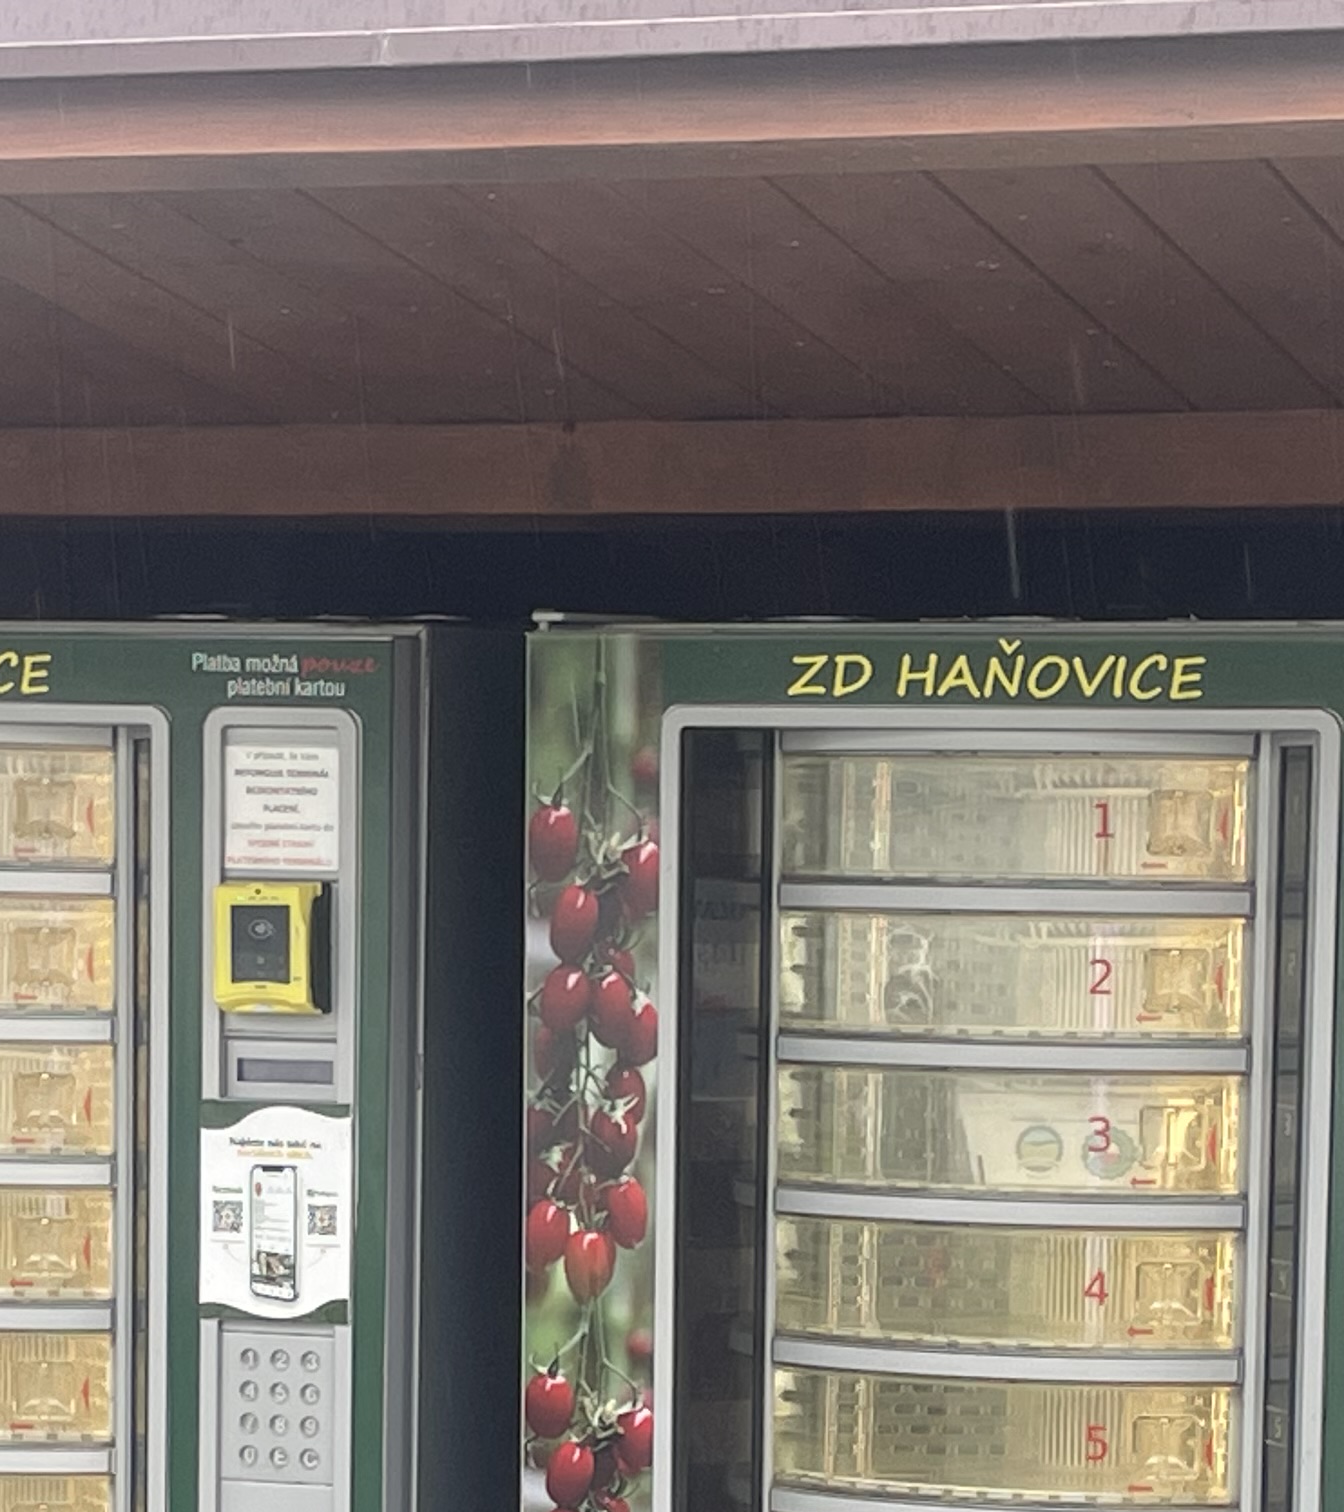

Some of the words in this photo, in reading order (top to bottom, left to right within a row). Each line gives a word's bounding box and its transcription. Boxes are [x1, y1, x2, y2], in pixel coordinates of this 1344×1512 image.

[191, 652, 241, 673] Platba
[245, 654, 299, 673] možná
[787, 654, 874, 696] ZD
[897, 639, 1207, 701] HAŇOVICE
[227, 677, 291, 699] platební
[294, 679, 346, 697] kartou
[1094, 803, 1115, 838] 1
[1089, 959, 1113, 995] 2
[1088, 1116, 1112, 1152] 3
[1084, 1270, 1108, 1305] 4
[1085, 1425, 1108, 1462] 5
